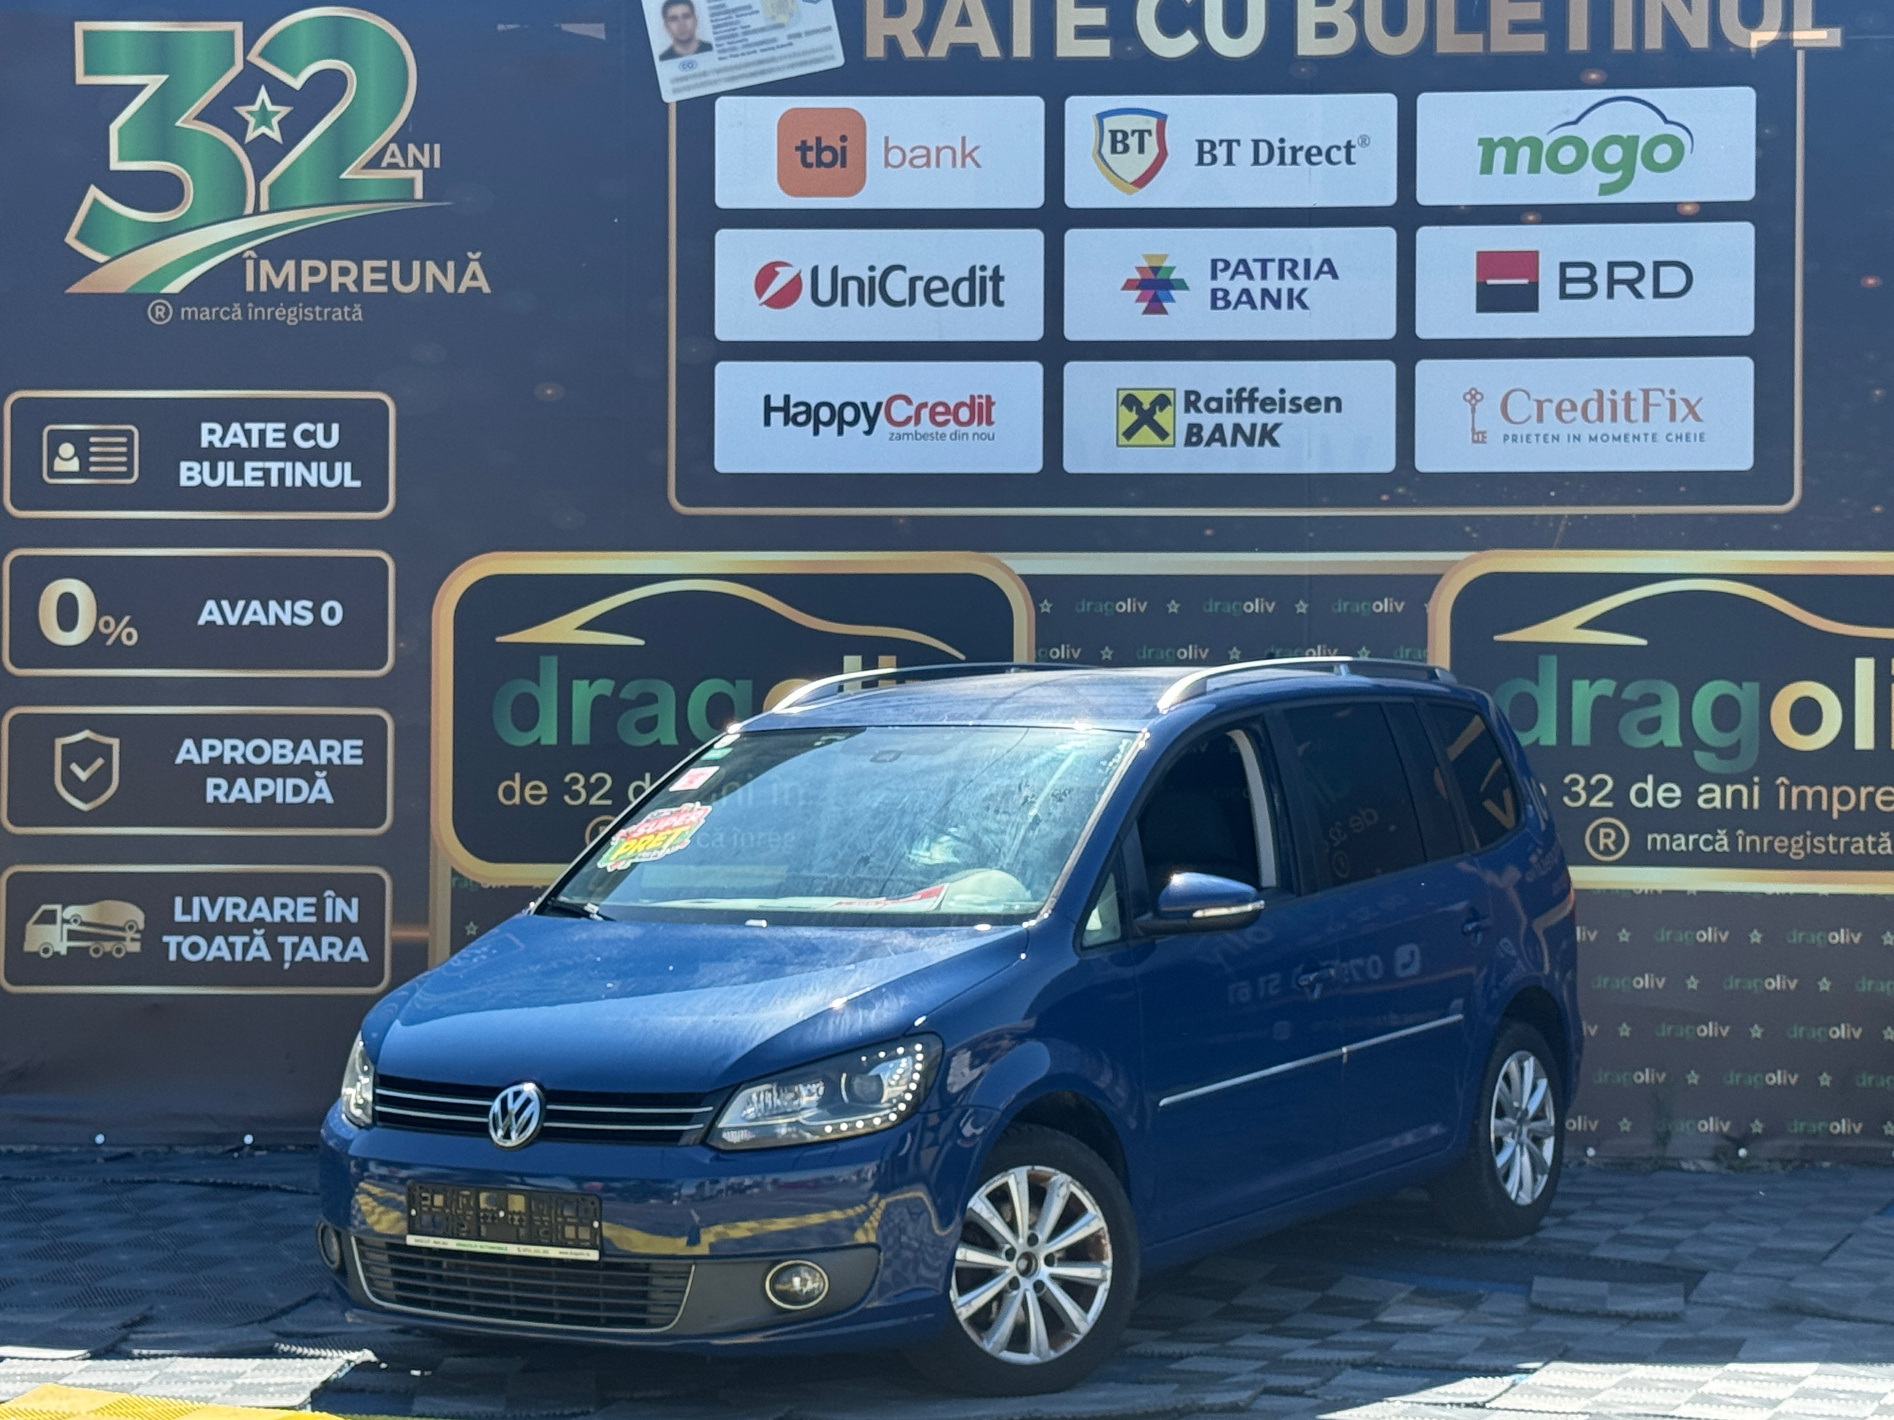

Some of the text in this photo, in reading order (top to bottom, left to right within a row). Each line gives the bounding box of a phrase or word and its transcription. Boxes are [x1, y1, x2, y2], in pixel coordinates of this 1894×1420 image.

[864, 0, 1111, 58] RATE
[1136, 0, 1266, 59] CU
[1296, 0, 1842, 57] BULETINUL
[795, 135, 848, 168] tbi
[884, 136, 981, 169] bank
[1109, 129, 1152, 154] BT
[1196, 139, 1240, 166] BT
[379, 141, 440, 168] ANI
[1477, 133, 1685, 197] mogo
[239, 247, 491, 293] ÎMPREUNĂ
[1211, 258, 1339, 281] PATRIA
[1559, 260, 1693, 300] BRD
[811, 264, 1005, 307] UniCredit
[181, 303, 242, 320] marcă
[1211, 288, 1309, 310] BANK
[1184, 387, 1342, 414] Raiffeisen
[1500, 388, 1703, 424] CreditFix
[764, 394, 995, 439] HappyCredit
[201, 423, 339, 448] RATE CU
[889, 425, 995, 441] zambeste din nou
[1184, 423, 1282, 447] BANK
[1503, 432, 1705, 444] PRIETEN IN MOMENTE CHEIE
[180, 461, 361, 487] BULETINUL
[198, 600, 343, 626] AVANS 0
[1074, 597, 1149, 618] dragoliv
[1201, 597, 1277, 617] dragoliv
[1331, 596, 1406, 617] dragoliv
[1136, 644, 1210, 663] dragoliv
[1490, 655, 1894, 773] dragol
[175, 739, 363, 765] APROBARE
[206, 771, 333, 803] RAPIDĂ
[498, 772, 548, 805] de
[564, 772, 612, 805] 32
[1563, 774, 1613, 807] 32
[1630, 775, 1681, 808] de
[1697, 777, 1759, 809] ani
[1648, 829, 1729, 852] marcă
[1737, 829, 1893, 859] înregistrată
[174, 890, 358, 923] LIVRARE ÎN
[1655, 927, 1730, 946] dragoliv
[1786, 928, 1863, 949] dragoliv
[162, 929, 370, 970] TOATĂ ȚARA
[1591, 973, 1667, 993] dragoliv
[1723, 974, 1799, 994] dragoliv
[1655, 1021, 1731, 1041] dragoliv
[1786, 1022, 1863, 1044] dragoliv
[1592, 1068, 1667, 1088] dragoliv
[1724, 1069, 1800, 1090] dragoliv
[1564, 1115, 1599, 1133] oliv
[1787, 1117, 1864, 1138] dragoliv
